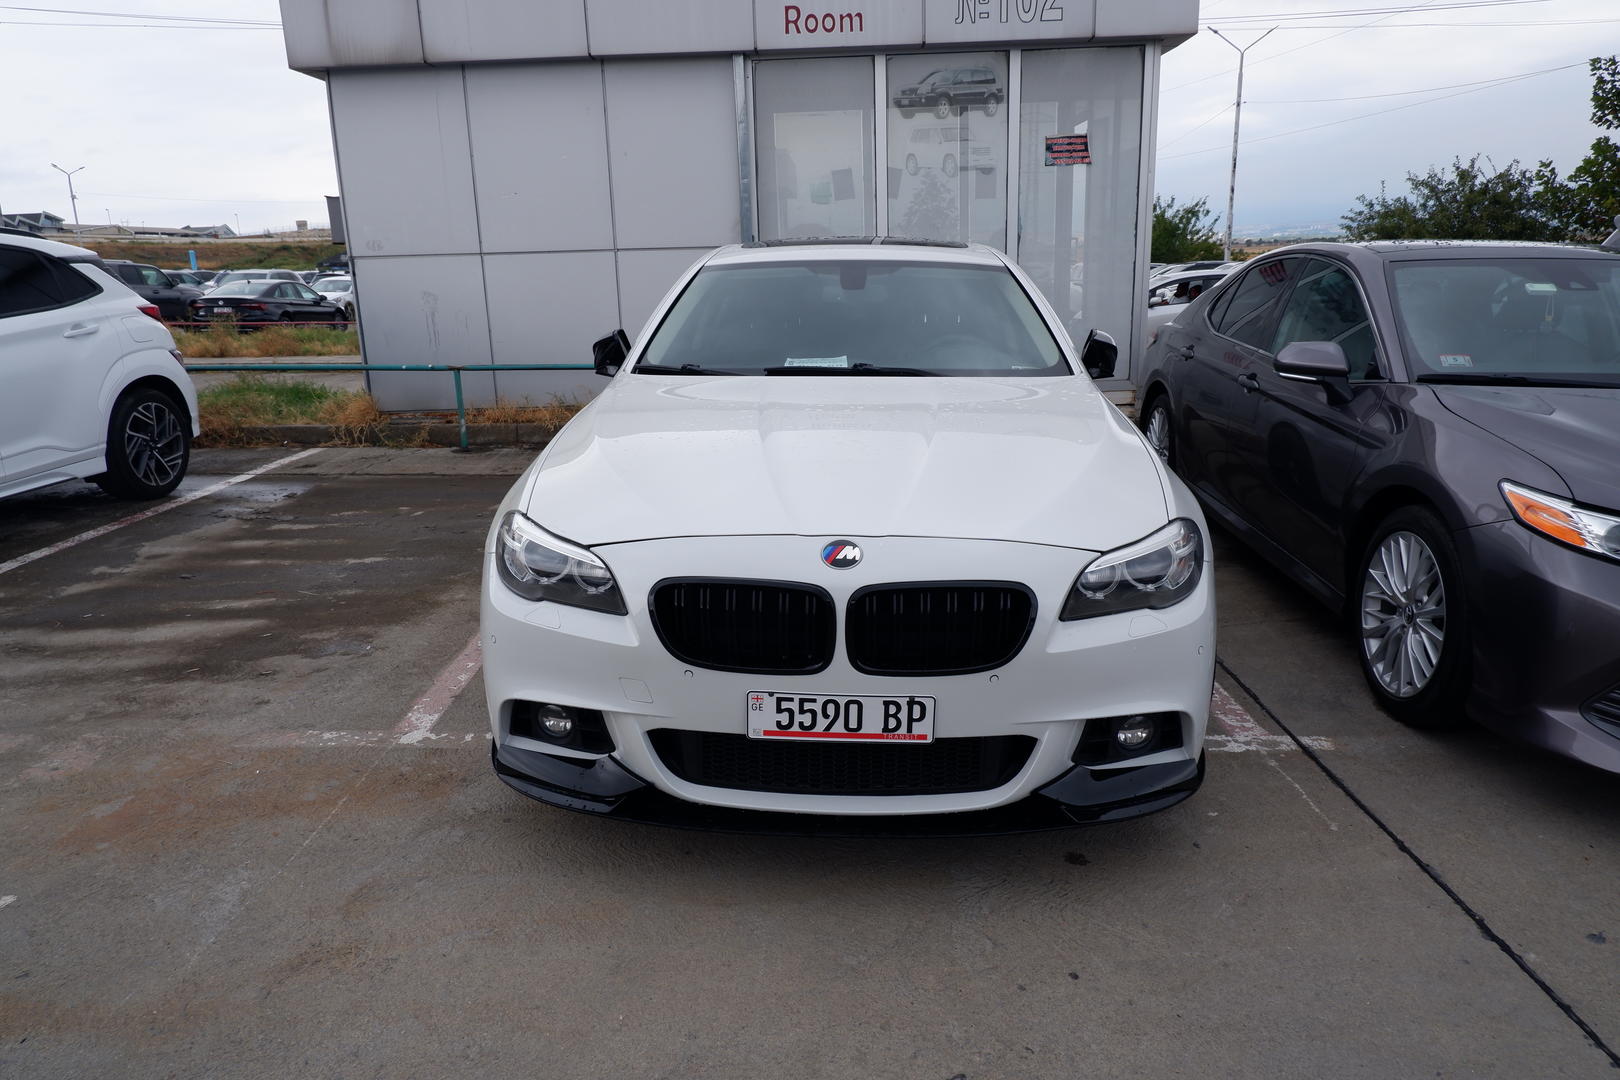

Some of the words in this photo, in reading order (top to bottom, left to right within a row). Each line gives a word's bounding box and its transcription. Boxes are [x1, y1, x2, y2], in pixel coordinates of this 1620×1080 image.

[784, 5, 864, 35] Room
[751, 702, 764, 711] GE
[775, 696, 864, 733] 5590
[881, 699, 927, 734] BP
